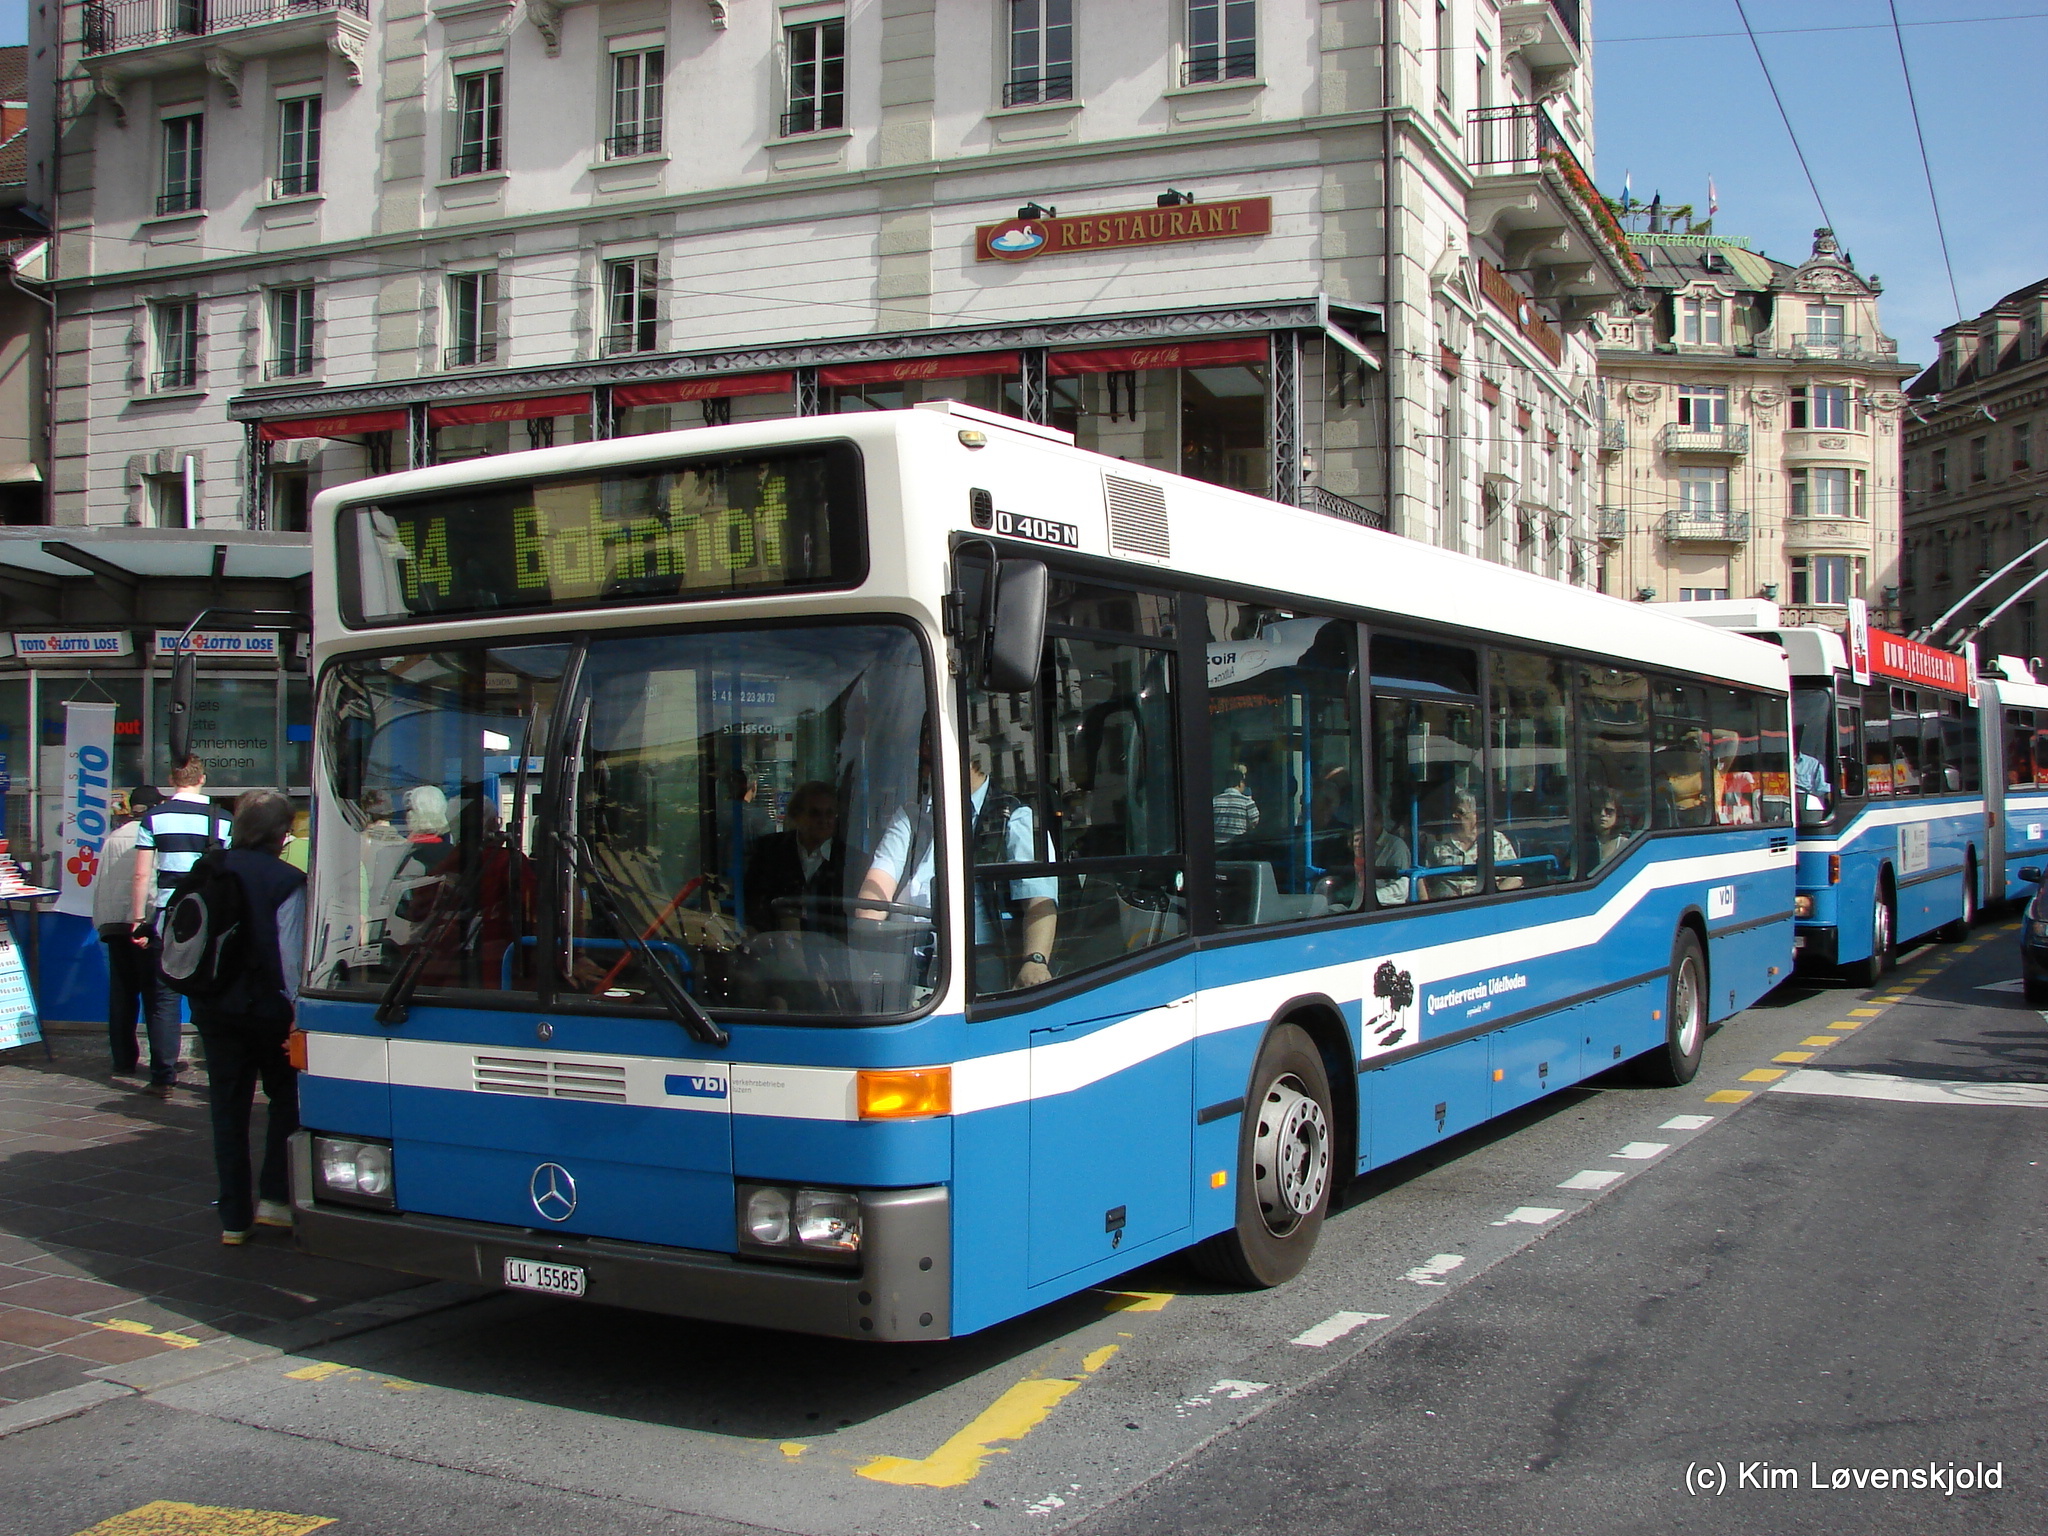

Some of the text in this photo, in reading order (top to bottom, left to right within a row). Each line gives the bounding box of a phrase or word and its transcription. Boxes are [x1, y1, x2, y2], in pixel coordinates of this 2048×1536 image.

[1061, 206, 1242, 247] RESTAURANT
[1624, 232, 1751, 248] ERSICHERUNGEN
[390, 475, 787, 600] 14 Bahnhof
[21, 638, 119, 651] TOTO LOTTO LOSE
[204, 638, 242, 649] LOTTO
[246, 638, 274, 650] LOSE
[1883, 641, 1955, 684] www.jetreisen.ch
[190, 738, 268, 749] onnemente
[202, 756, 255, 768] rsionen
[67, 752, 79, 845] SWISS
[76, 745, 110, 853] LOTTO
[1427, 981, 1488, 1016] Quartierverein
[1488, 972, 1527, 996] Udelboden
[691, 1076, 725, 1092] vbl
[732, 1078, 786, 1089] verkehrsbetriebe
